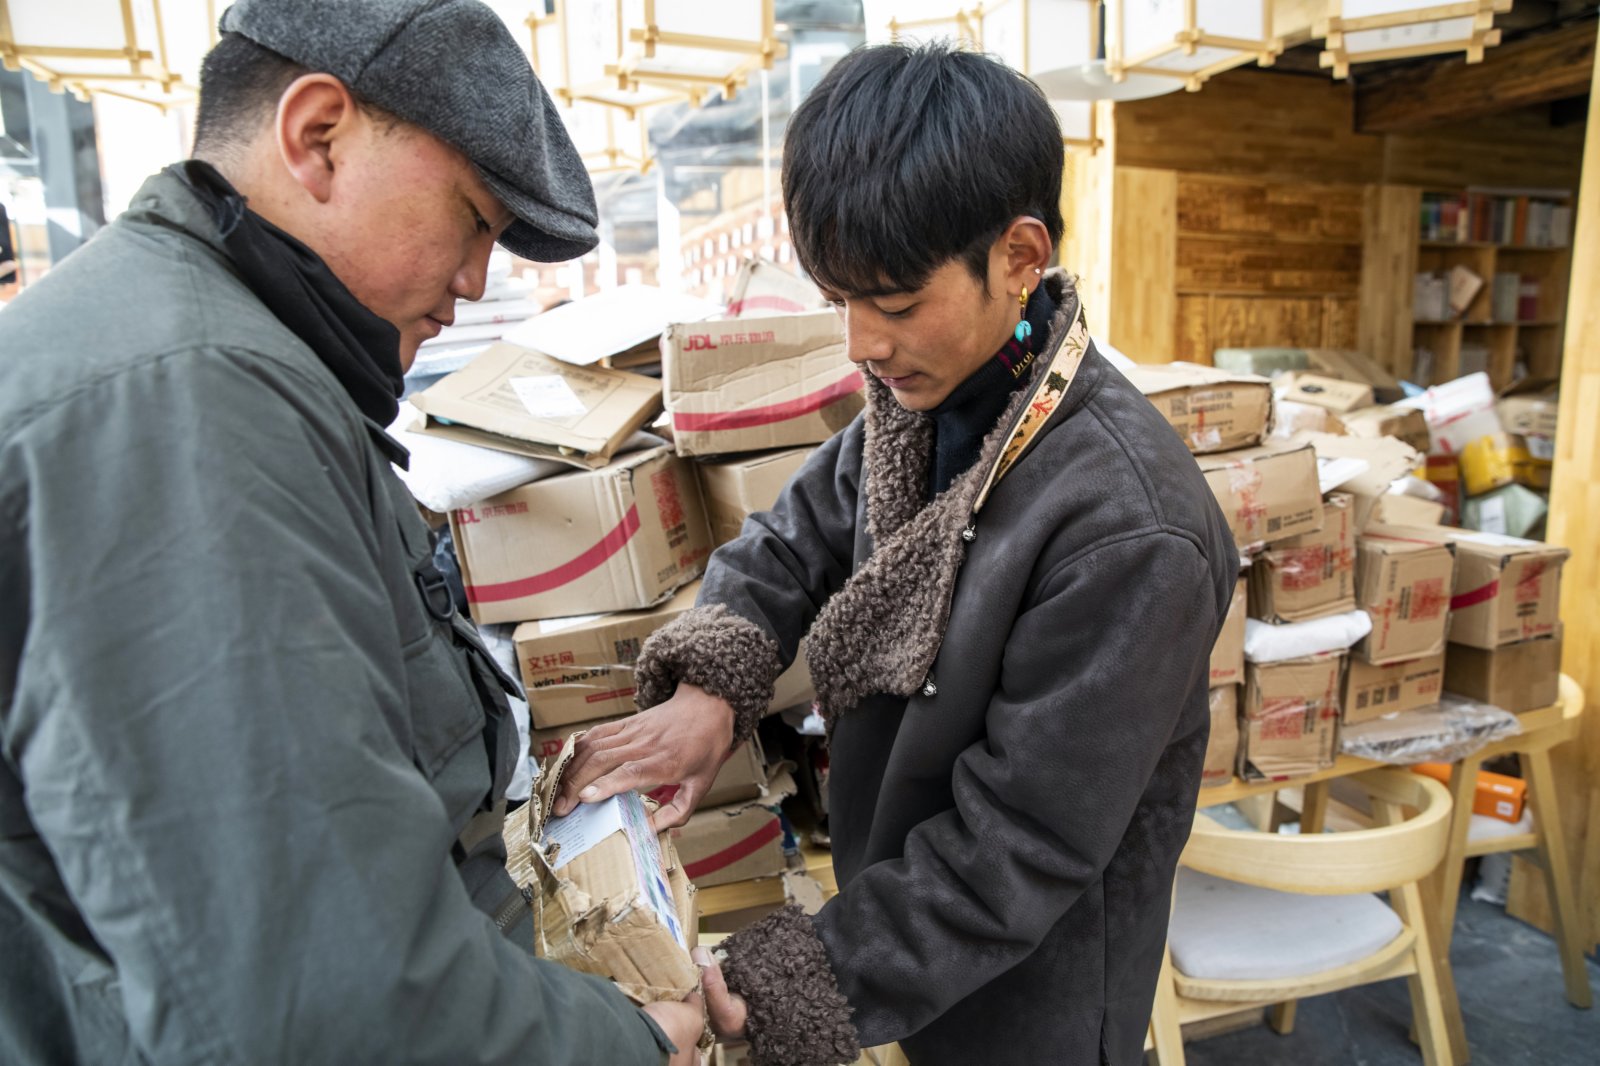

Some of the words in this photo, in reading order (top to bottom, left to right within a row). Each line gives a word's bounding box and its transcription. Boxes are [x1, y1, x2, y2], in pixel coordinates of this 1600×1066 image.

[683, 334, 718, 351] JDL
[528, 651, 575, 671] 文轩网
[533, 671, 589, 688] winshare
[539, 738, 563, 757] JD
